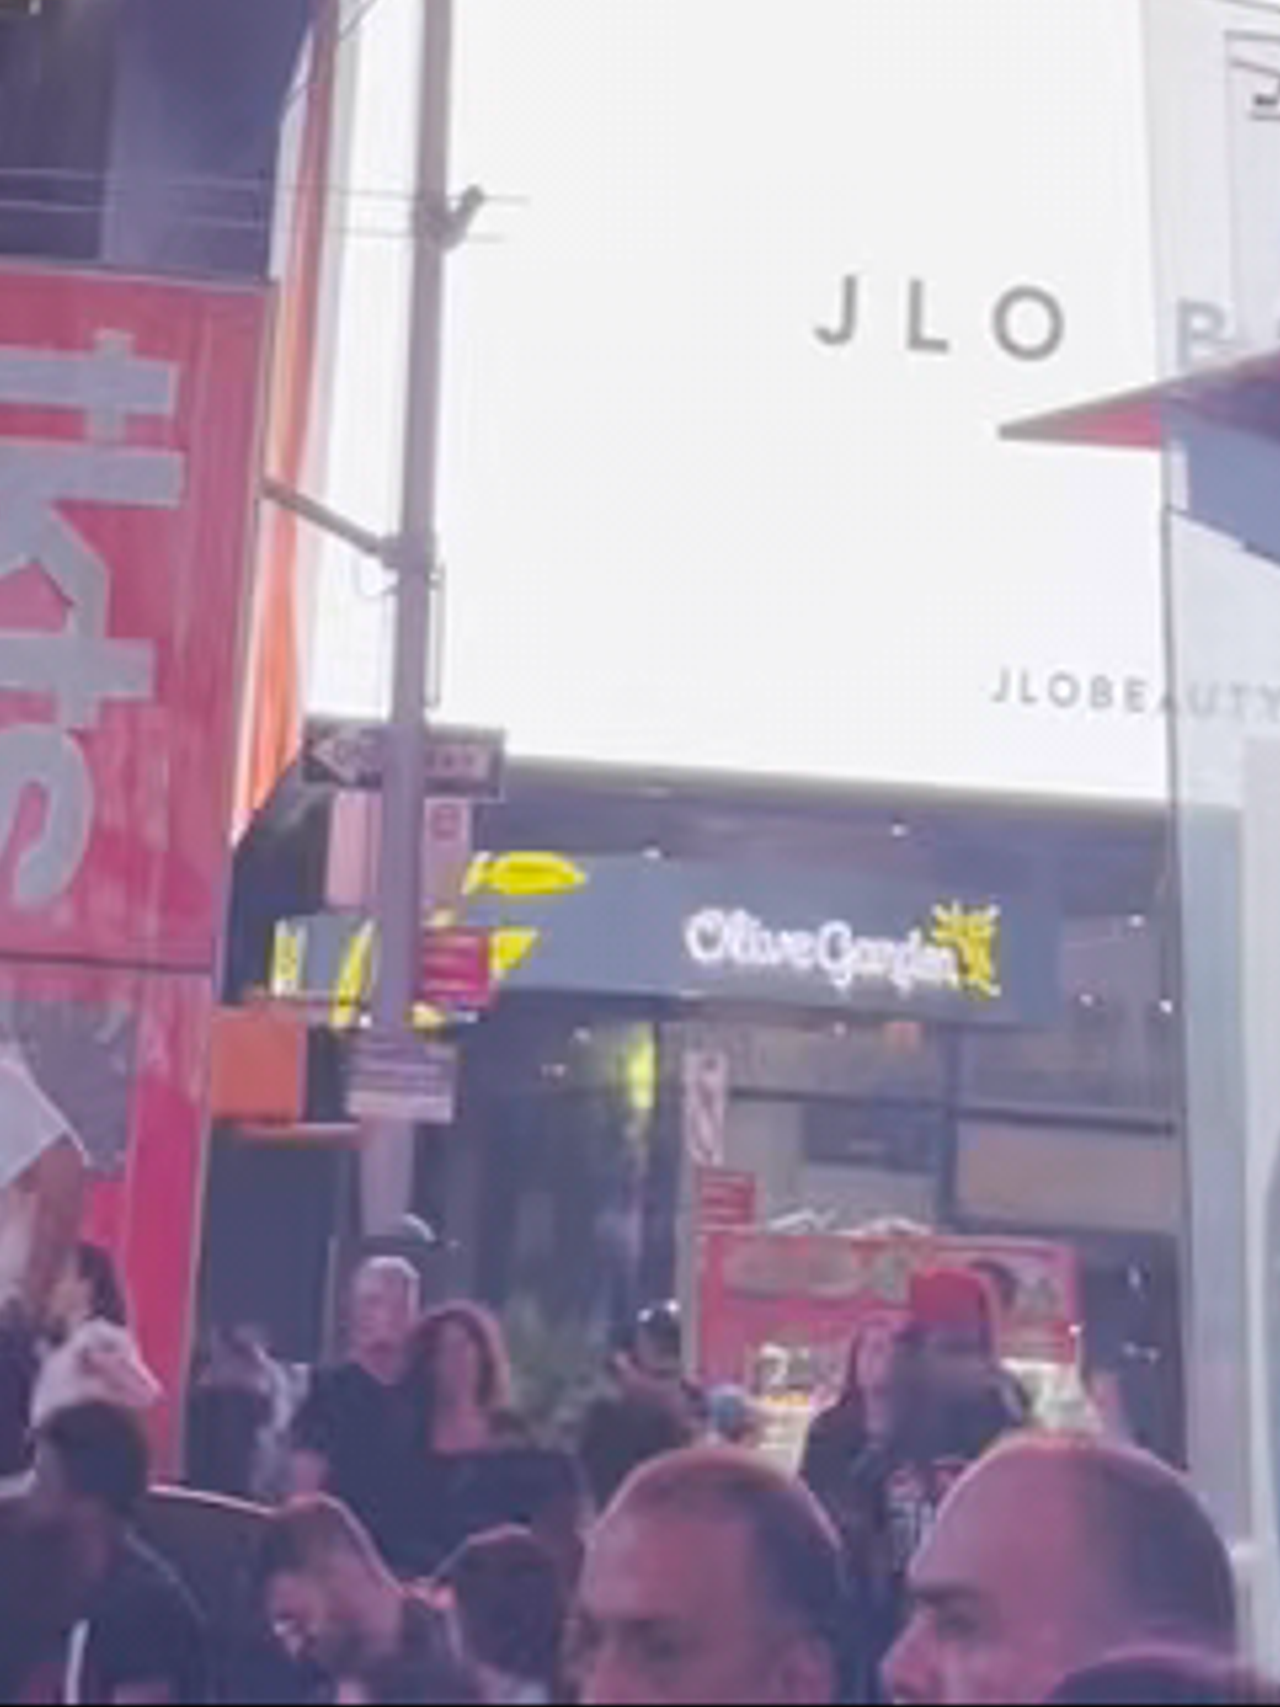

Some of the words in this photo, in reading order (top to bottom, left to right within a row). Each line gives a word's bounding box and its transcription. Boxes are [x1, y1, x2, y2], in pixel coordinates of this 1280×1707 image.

[814, 273, 1066, 363] JLO
[684, 907, 819, 970] Olive
[818, 918, 960, 1001] Garden
